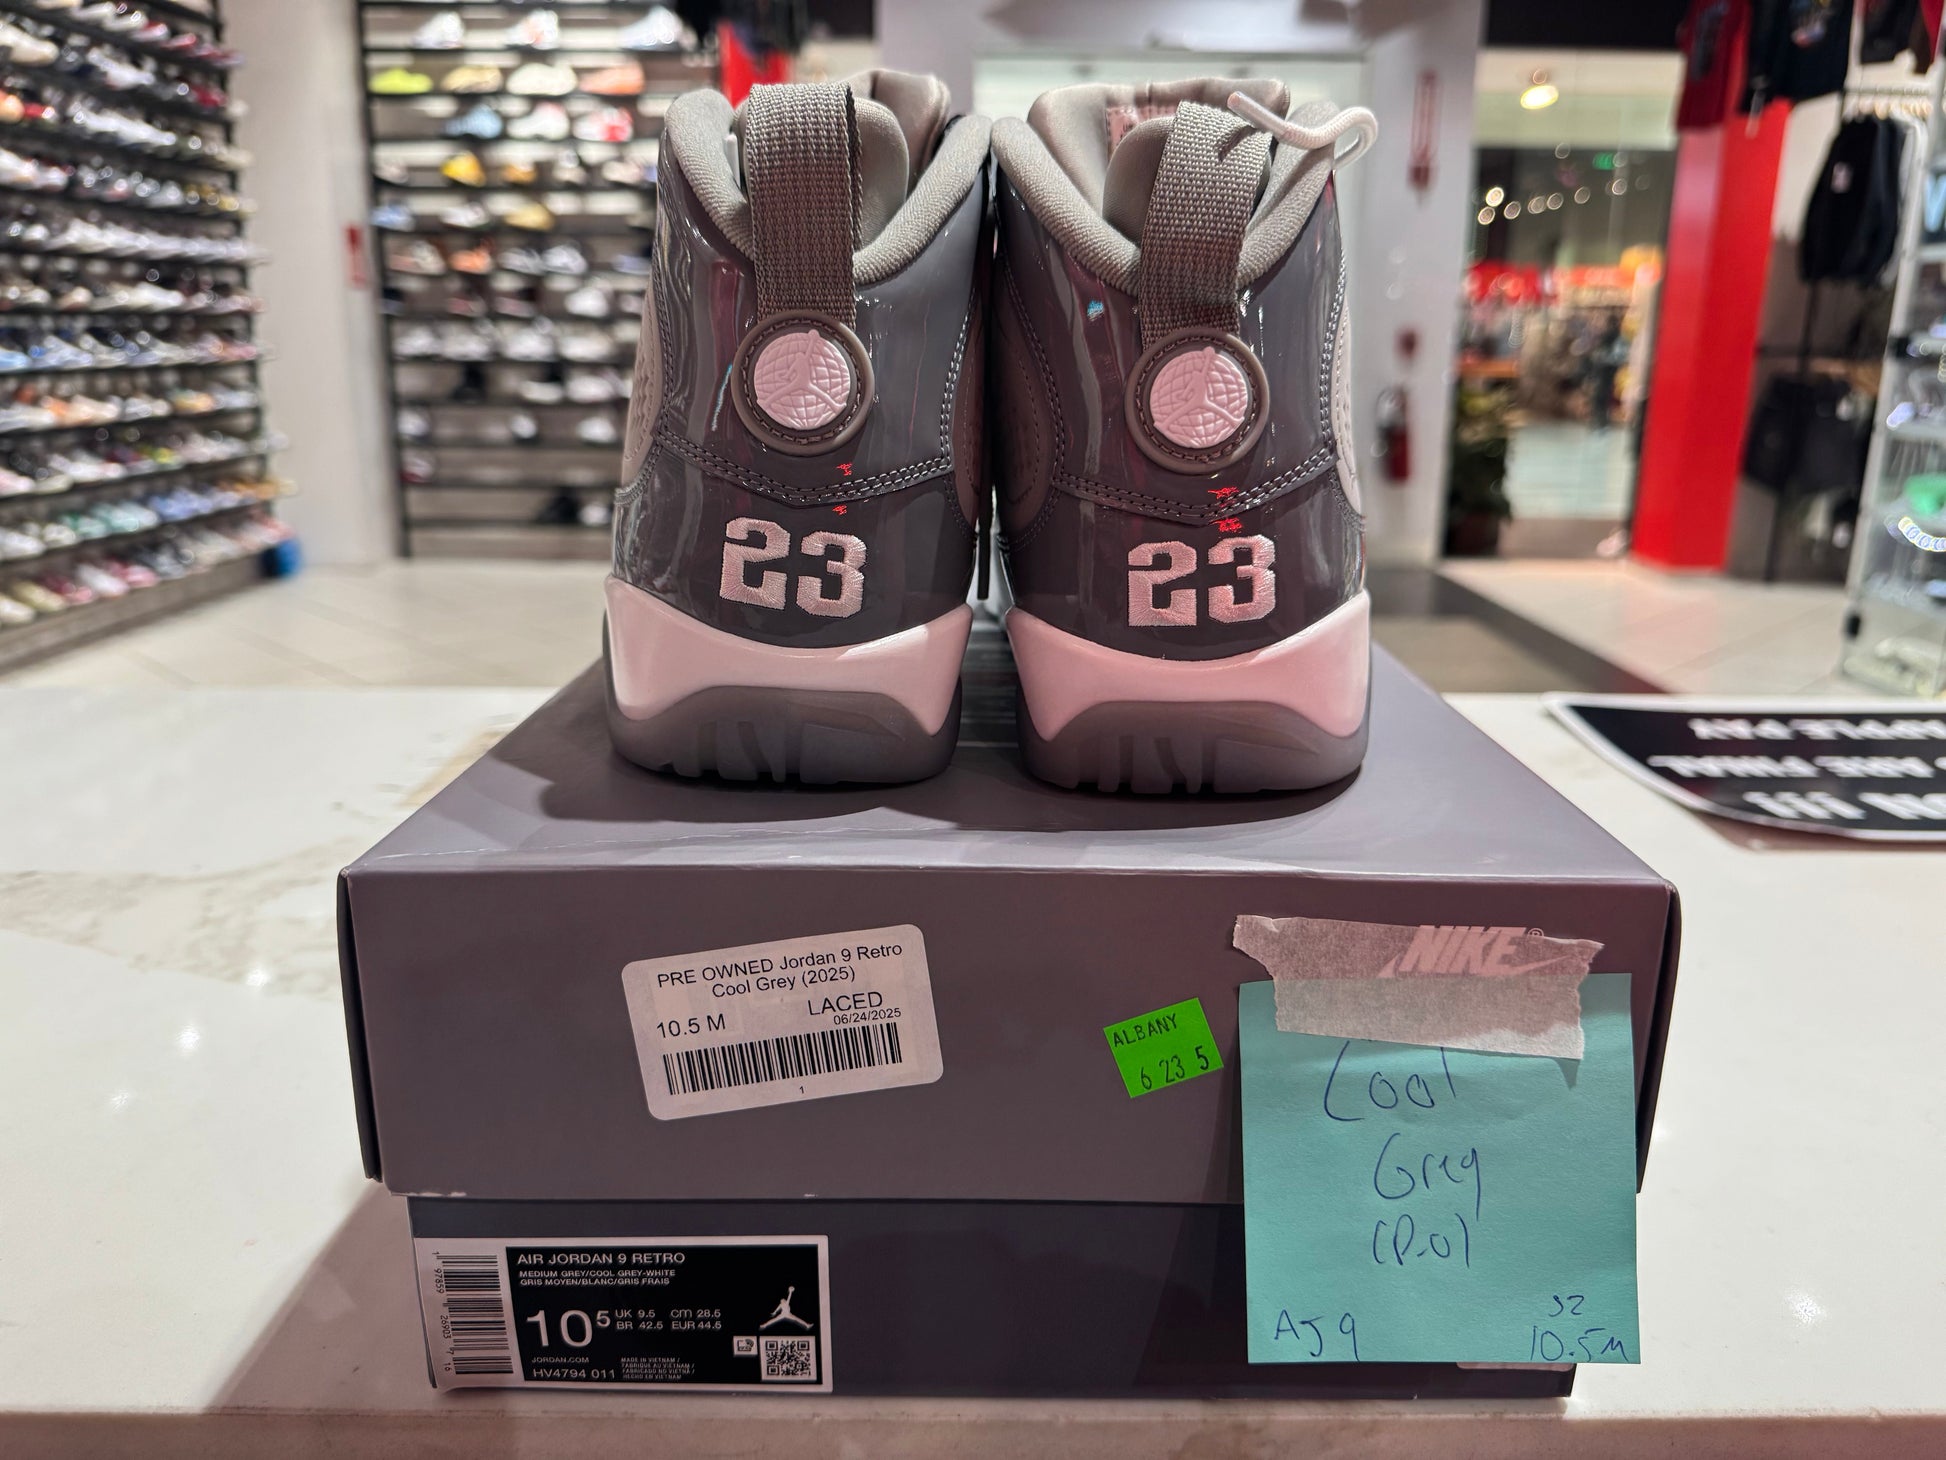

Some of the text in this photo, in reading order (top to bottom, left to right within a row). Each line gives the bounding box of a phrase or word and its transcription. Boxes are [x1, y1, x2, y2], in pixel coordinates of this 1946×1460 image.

[718, 516, 868, 618] 23
[1127, 533, 1277, 627] 23
[1399, 924, 1528, 974] NIKE
[657, 942, 903, 988] PRE OWNED Jordan 9 Retro
[711, 965, 856, 998] Cool Grey (2025)
[807, 990, 883, 1016] LACED
[656, 1013, 727, 1039] 10.5 M
[833, 1006, 902, 1026] 06/24/2025
[1112, 1012, 1178, 1048] ALBANY
[1140, 1067, 1153, 1090] 6
[1195, 1045, 1210, 1070] 5
[799, 1085, 806, 1095] 1
[517, 1252, 686, 1265] AIR JORDAN 9 RETRO
[519, 1269, 676, 1278] MEDIUM GREY/COOL GREY-WHITE
[520, 1277, 670, 1287] GRIS MOYEN/BLANC/GRIS FRAIS
[615, 1309, 633, 1318] UK
[637, 1309, 656, 1318] 9.5
[696, 1309, 721, 1318] 28.5
[616, 1320, 722, 1330] BR 42.5 EUR 44.5
[531, 1356, 590, 1364] JORDAN.COM
[533, 1368, 616, 1379] HV4794 011
